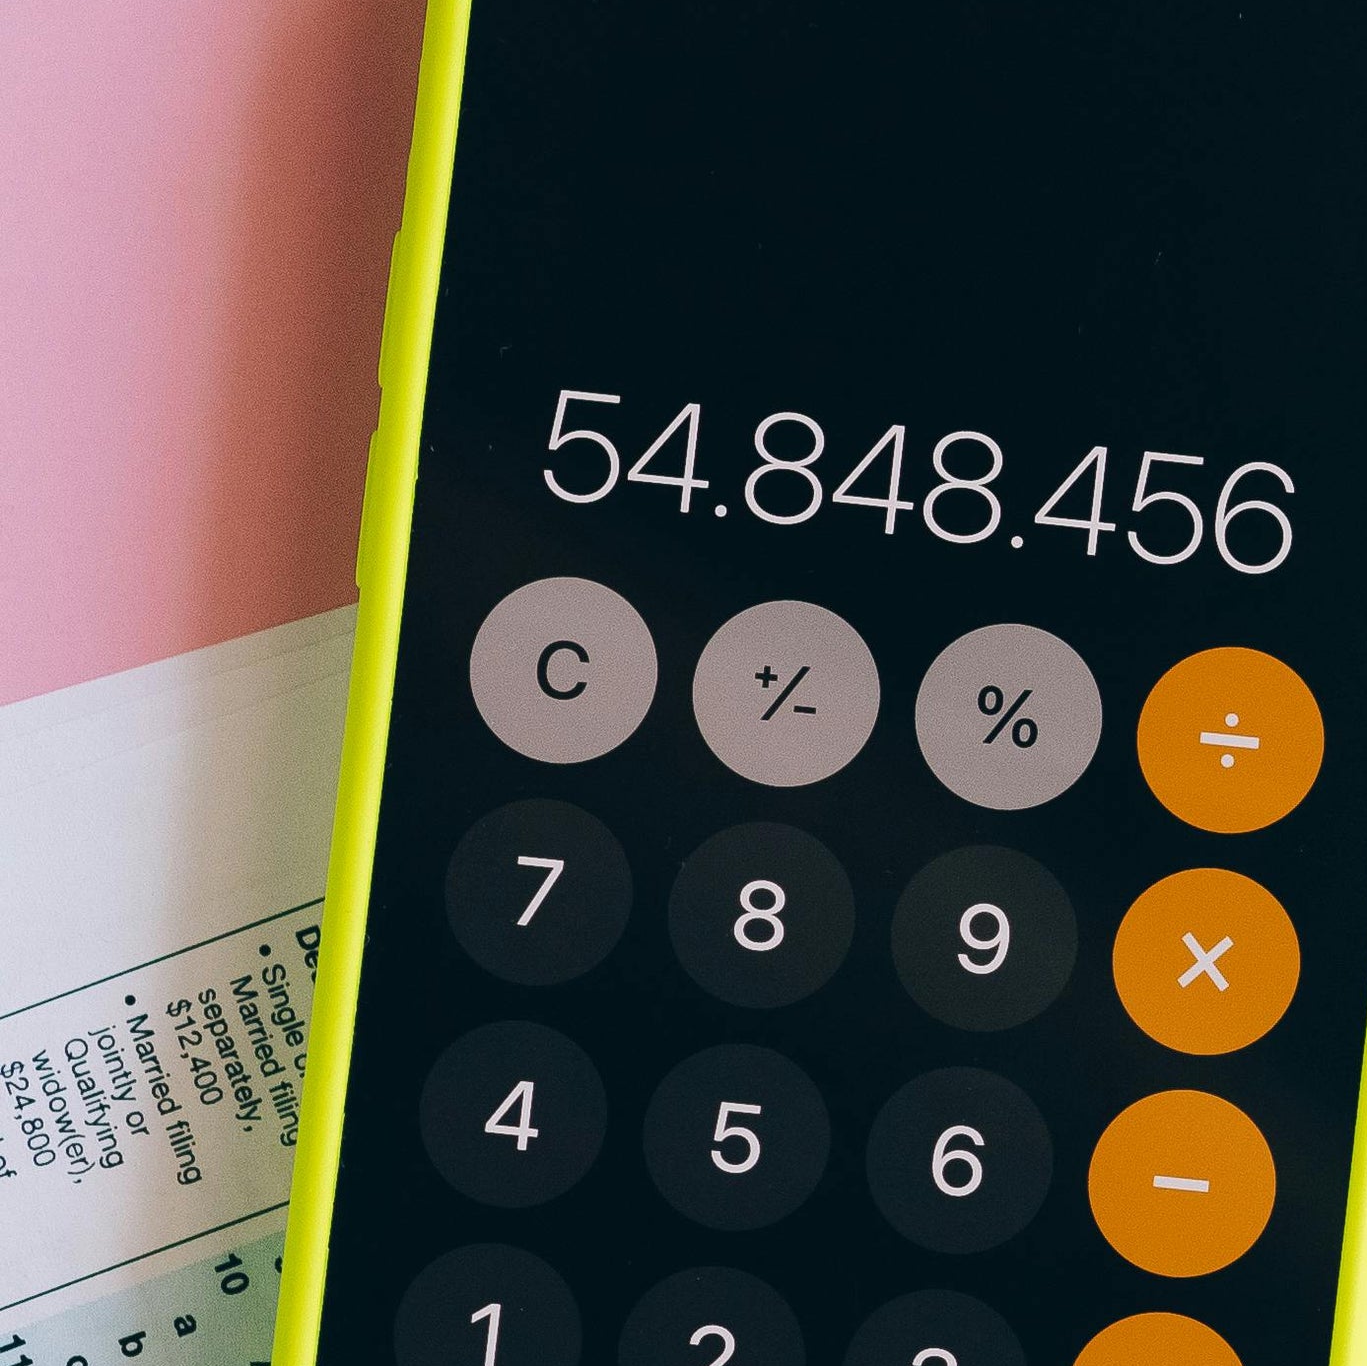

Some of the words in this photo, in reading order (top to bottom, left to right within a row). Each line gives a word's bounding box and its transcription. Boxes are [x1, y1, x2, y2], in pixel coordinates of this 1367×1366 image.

[543, 389, 1295, 574] 54.848.456
[536, 639, 590, 701] C
[977, 684, 1039, 749] %
[516, 855, 565, 927] 7
[733, 879, 786, 952] 8
[957, 902, 1010, 975] 9
[165, 998, 223, 1105] $12,400
[197, 987, 263, 1132] separately,
[229, 973, 286, 1077] Married
[268, 1080, 299, 1147] filing
[261, 963, 306, 1047] Single
[2, 1060, 56, 1167] $24,800
[31, 1048, 96, 1184] widow(er),
[63, 1037, 124, 1169] Qualifying
[87, 1024, 137, 1101] jointly
[124, 1110, 150, 1135] or
[125, 1012, 182, 1116] Married
[164, 1119, 203, 1185] filing
[484, 1080, 539, 1151] 4
[710, 1101, 762, 1174] 5
[931, 1124, 986, 1197] 6
